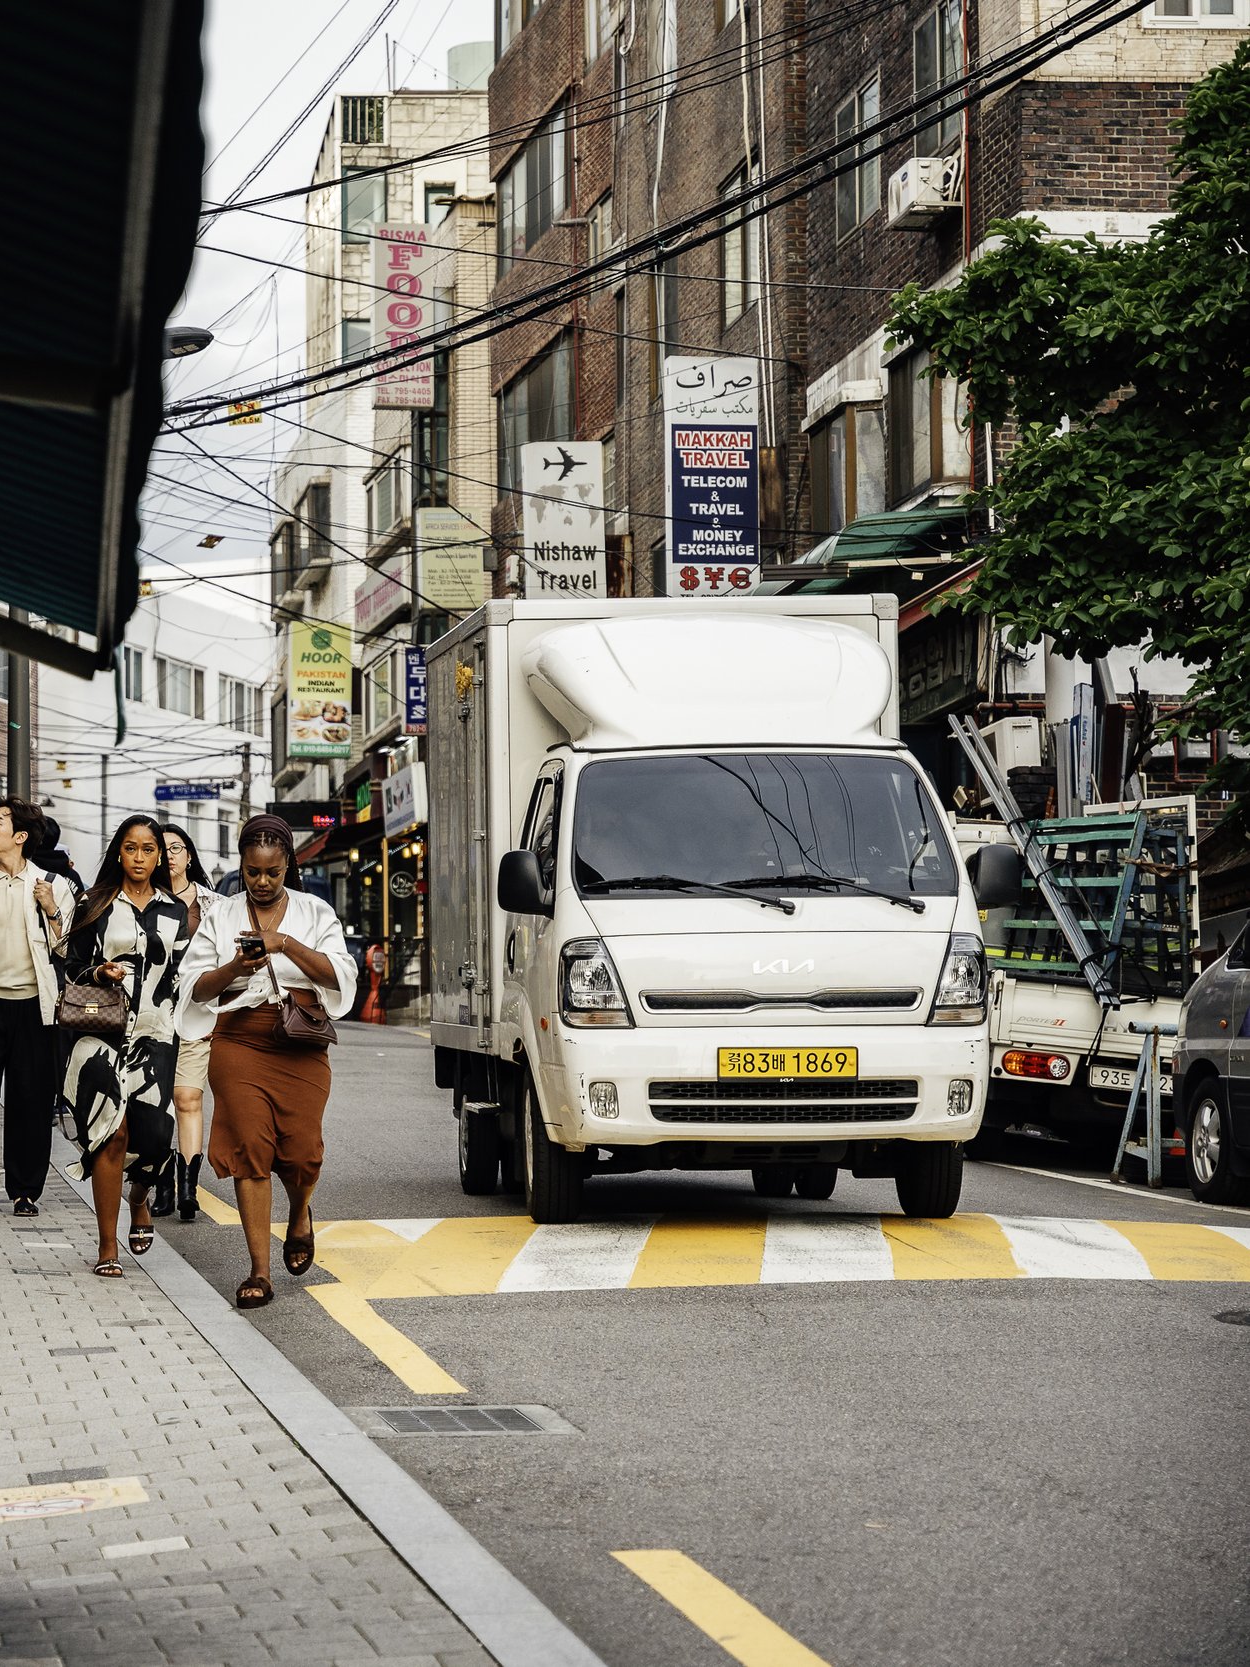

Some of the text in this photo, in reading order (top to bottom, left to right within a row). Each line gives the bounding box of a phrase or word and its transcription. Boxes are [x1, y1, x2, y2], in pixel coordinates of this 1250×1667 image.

[379, 229, 427, 242] BISMA
[676, 364, 752, 398] صراف
[676, 394, 753, 419] مكتب سفريات
[676, 431, 752, 449] MAKKAH
[680, 451, 750, 468] TRAVEL
[681, 475, 748, 488] TELECOM
[711, 490, 720, 501] &
[689, 503, 744, 515] TRAVEL
[712, 517, 721, 528] &
[692, 530, 743, 541] MONEY
[534, 540, 597, 561] Nishaw
[678, 543, 755, 556] EXCHANGE
[537, 570, 597, 590] Travel
[301, 652, 342, 663] HOOR
[297, 670, 347, 679] PAKISTAN
[792, 1052, 847, 1073] 1869
